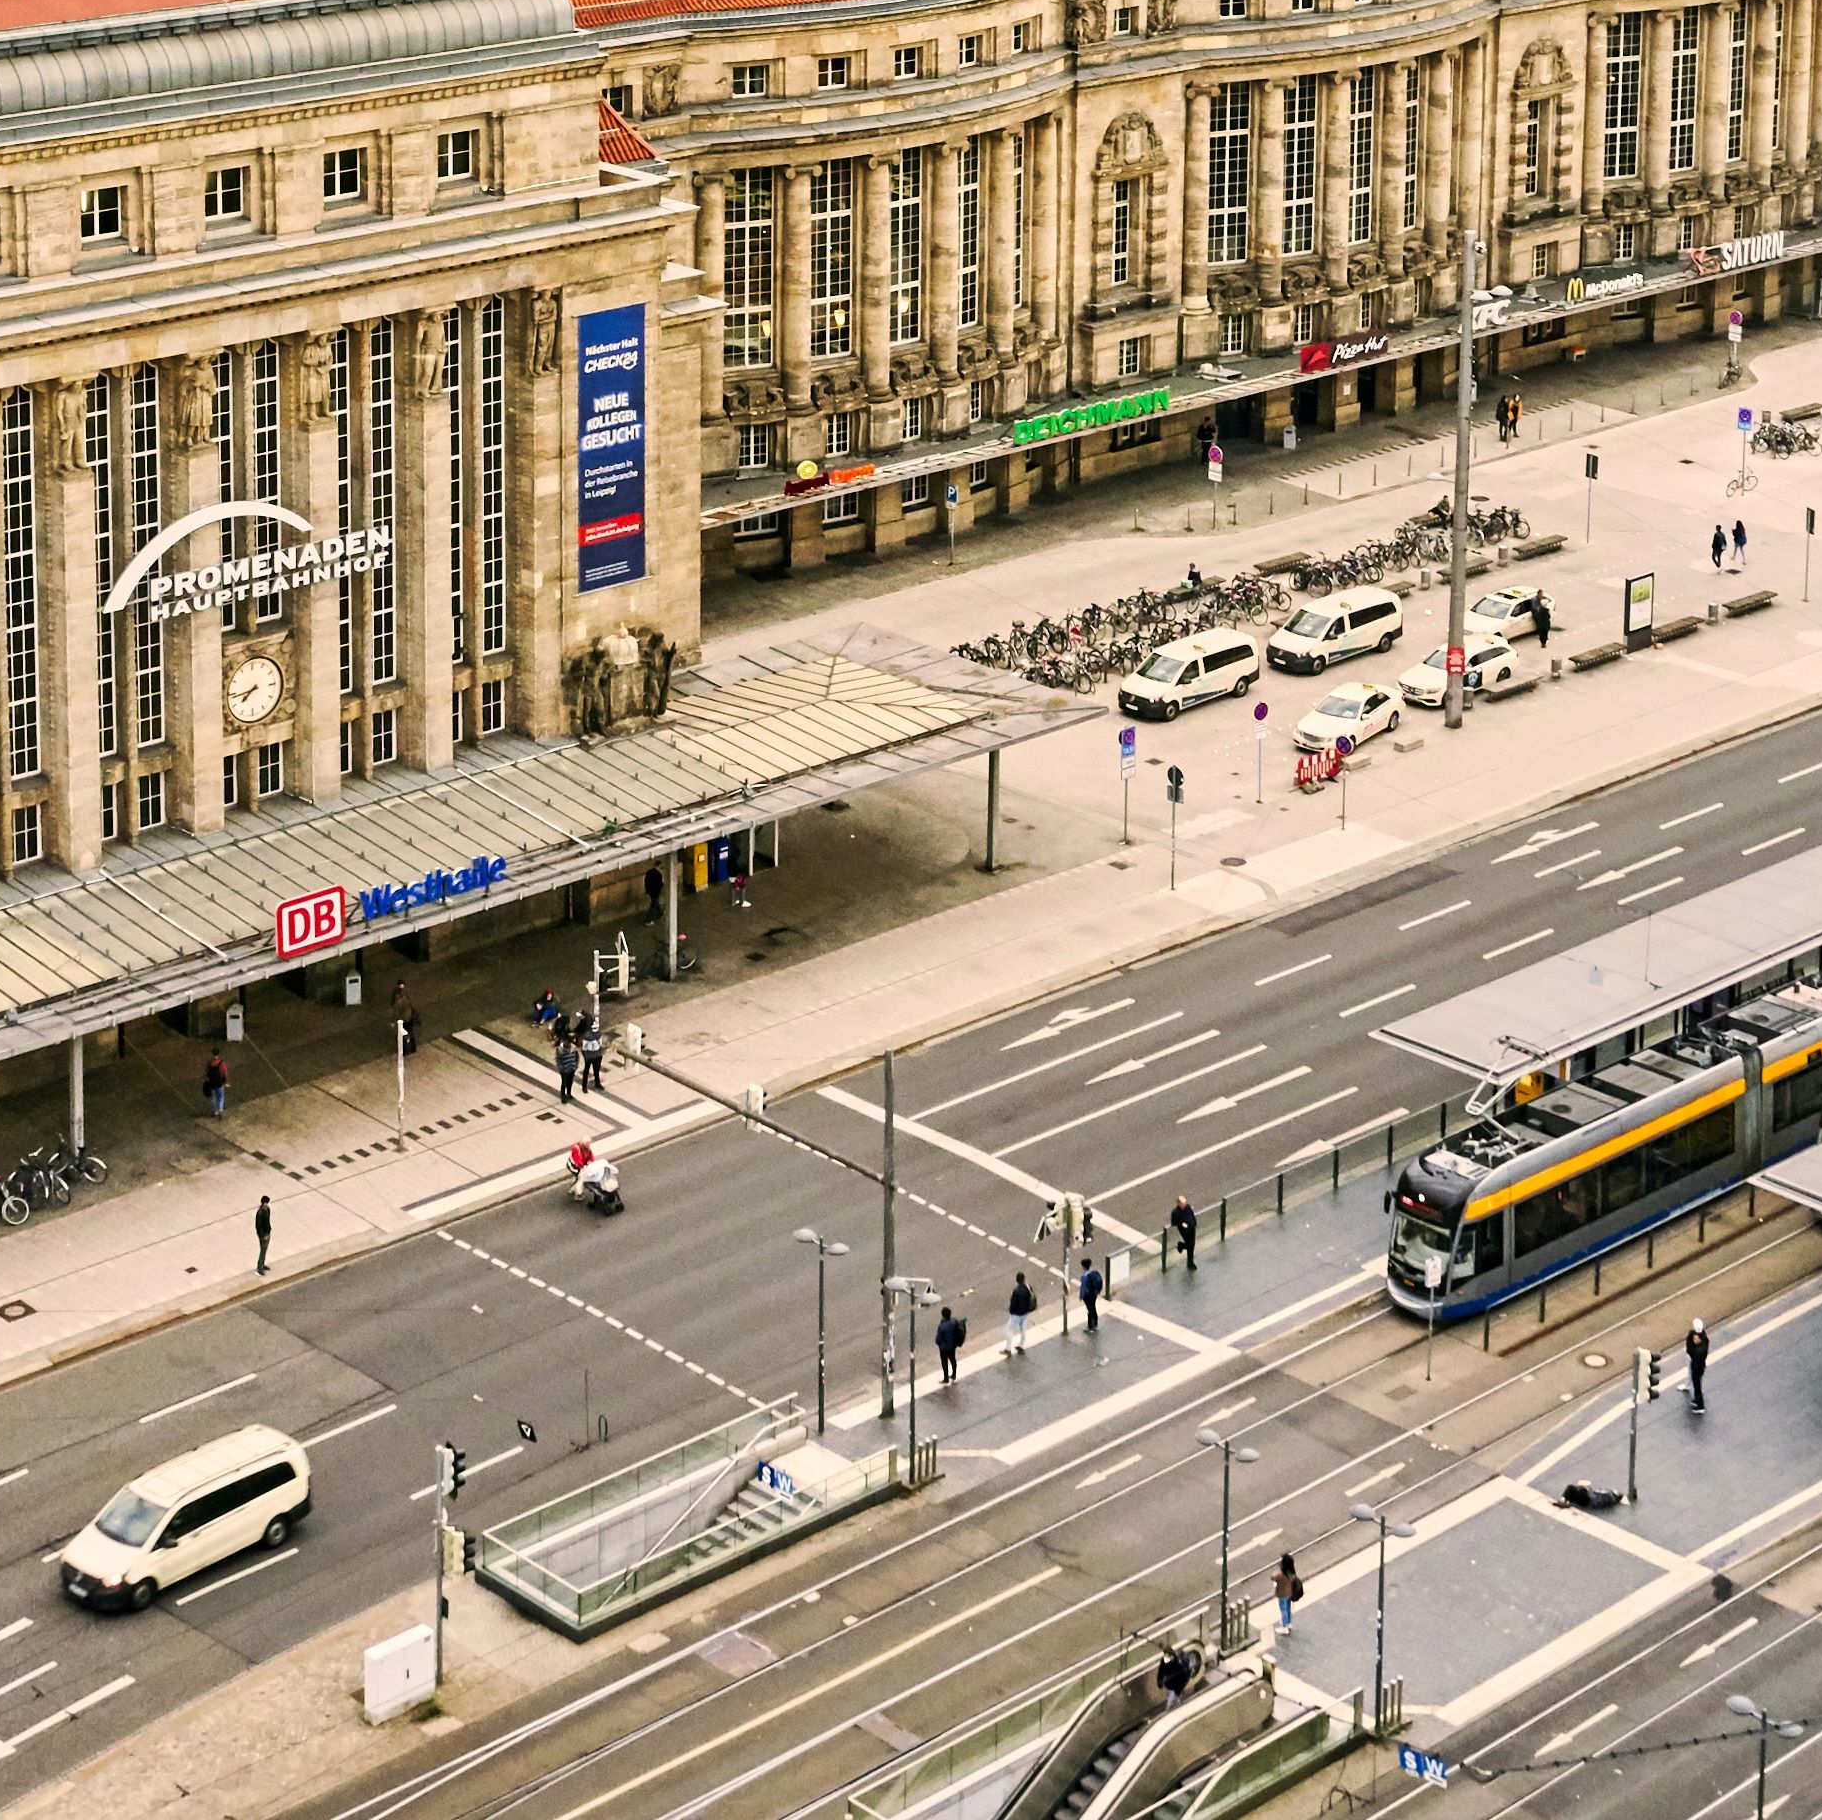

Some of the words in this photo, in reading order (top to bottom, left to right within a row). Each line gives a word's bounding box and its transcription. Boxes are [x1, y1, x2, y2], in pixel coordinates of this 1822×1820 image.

[1722, 230, 1784, 270] SATURN
[1585, 272, 1644, 298] McDonald's
[585, 342, 621, 356] Nächster
[621, 337, 639, 348] Halt
[1332, 343, 1365, 364] Pizza
[1364, 333, 1389, 354] Hut
[584, 350, 639, 373] CHECK24
[594, 392, 630, 413] NEUE
[1013, 385, 1171, 445] DEICHMANN
[586, 410, 637, 432] KOLLEGEN
[581, 423, 643, 451] GESUCHT
[151, 525, 390, 603] PROMENADEN
[151, 551, 390, 622] HAUPTBAHNHOF
[287, 898, 337, 946] DB
[359, 853, 507, 921] Westhalle
